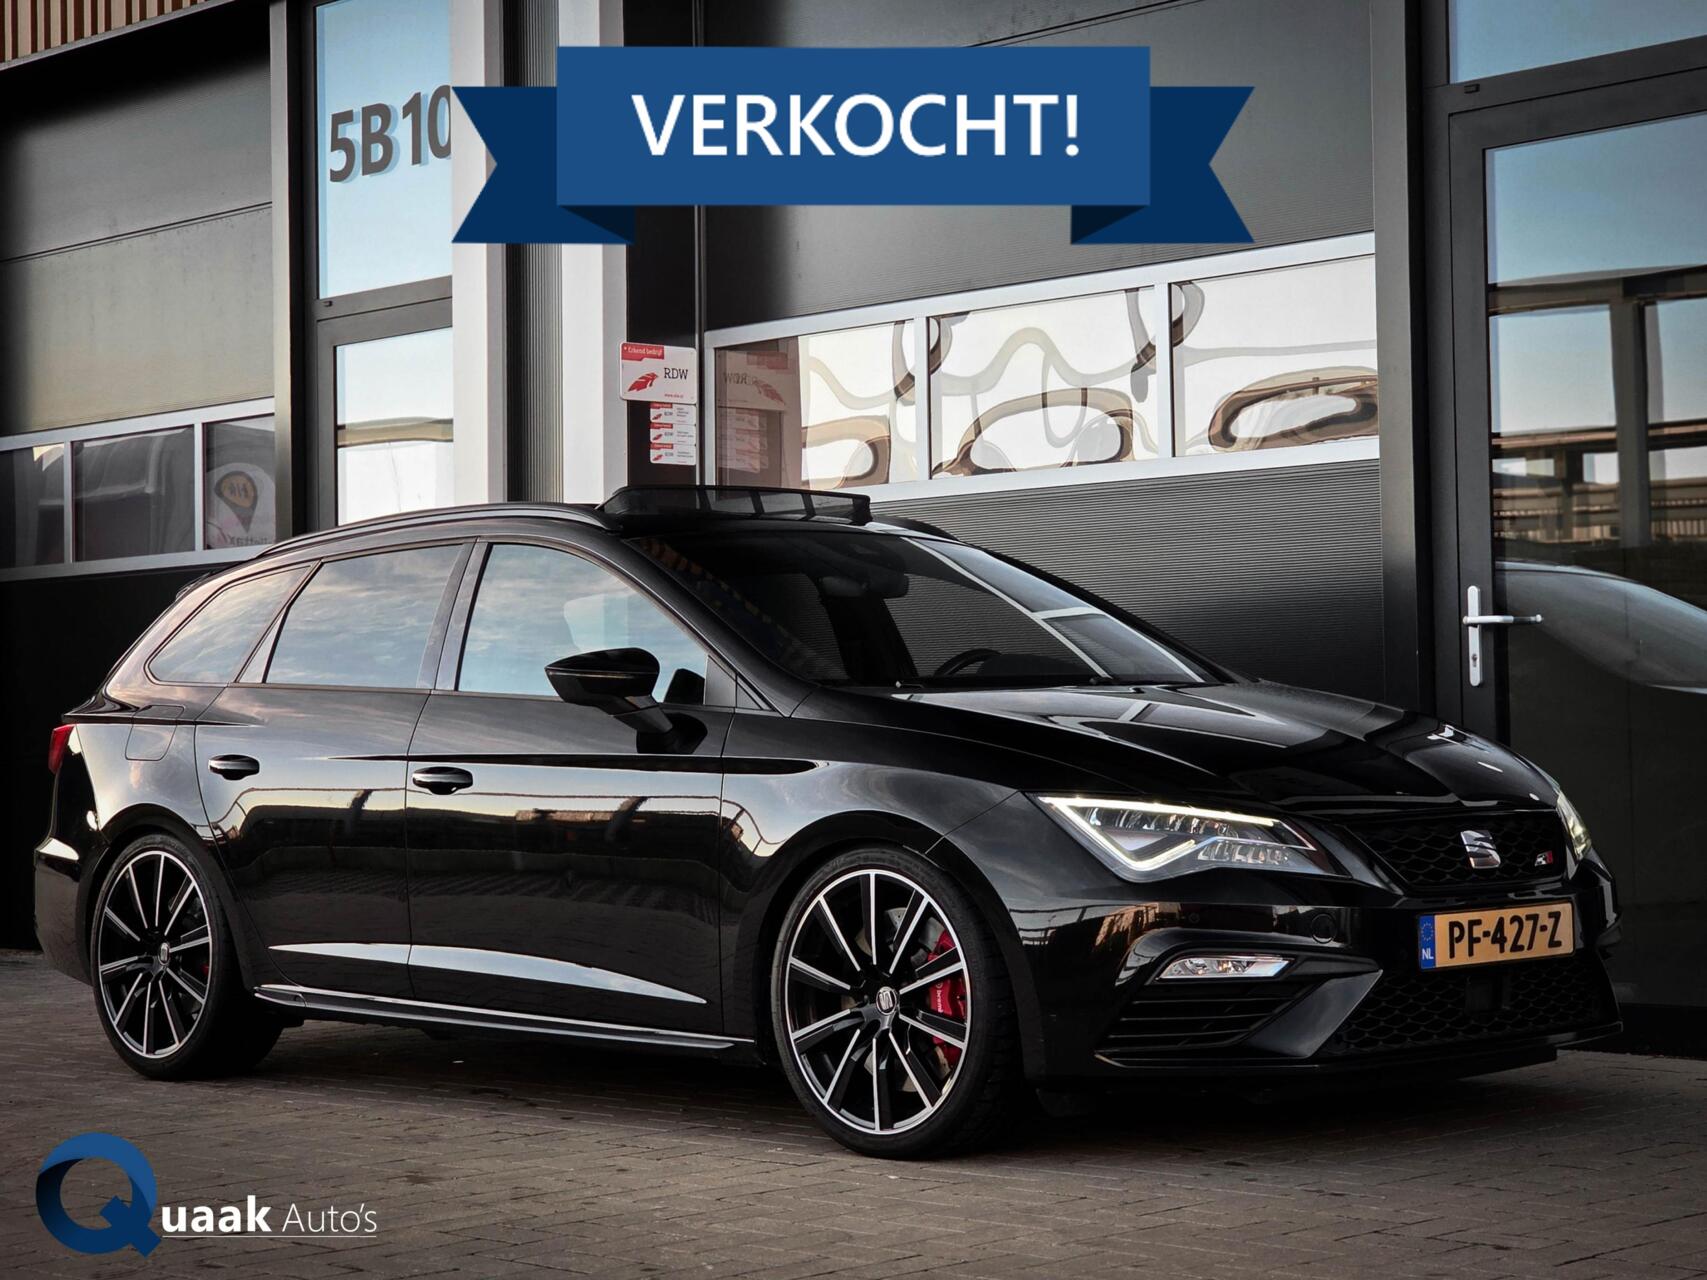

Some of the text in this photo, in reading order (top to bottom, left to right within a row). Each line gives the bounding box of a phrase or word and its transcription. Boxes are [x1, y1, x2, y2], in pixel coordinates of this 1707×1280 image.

[664, 367, 689, 380] RDW
[1448, 911, 1562, 960] PF-427-Z
[1421, 948, 1434, 960] NL
